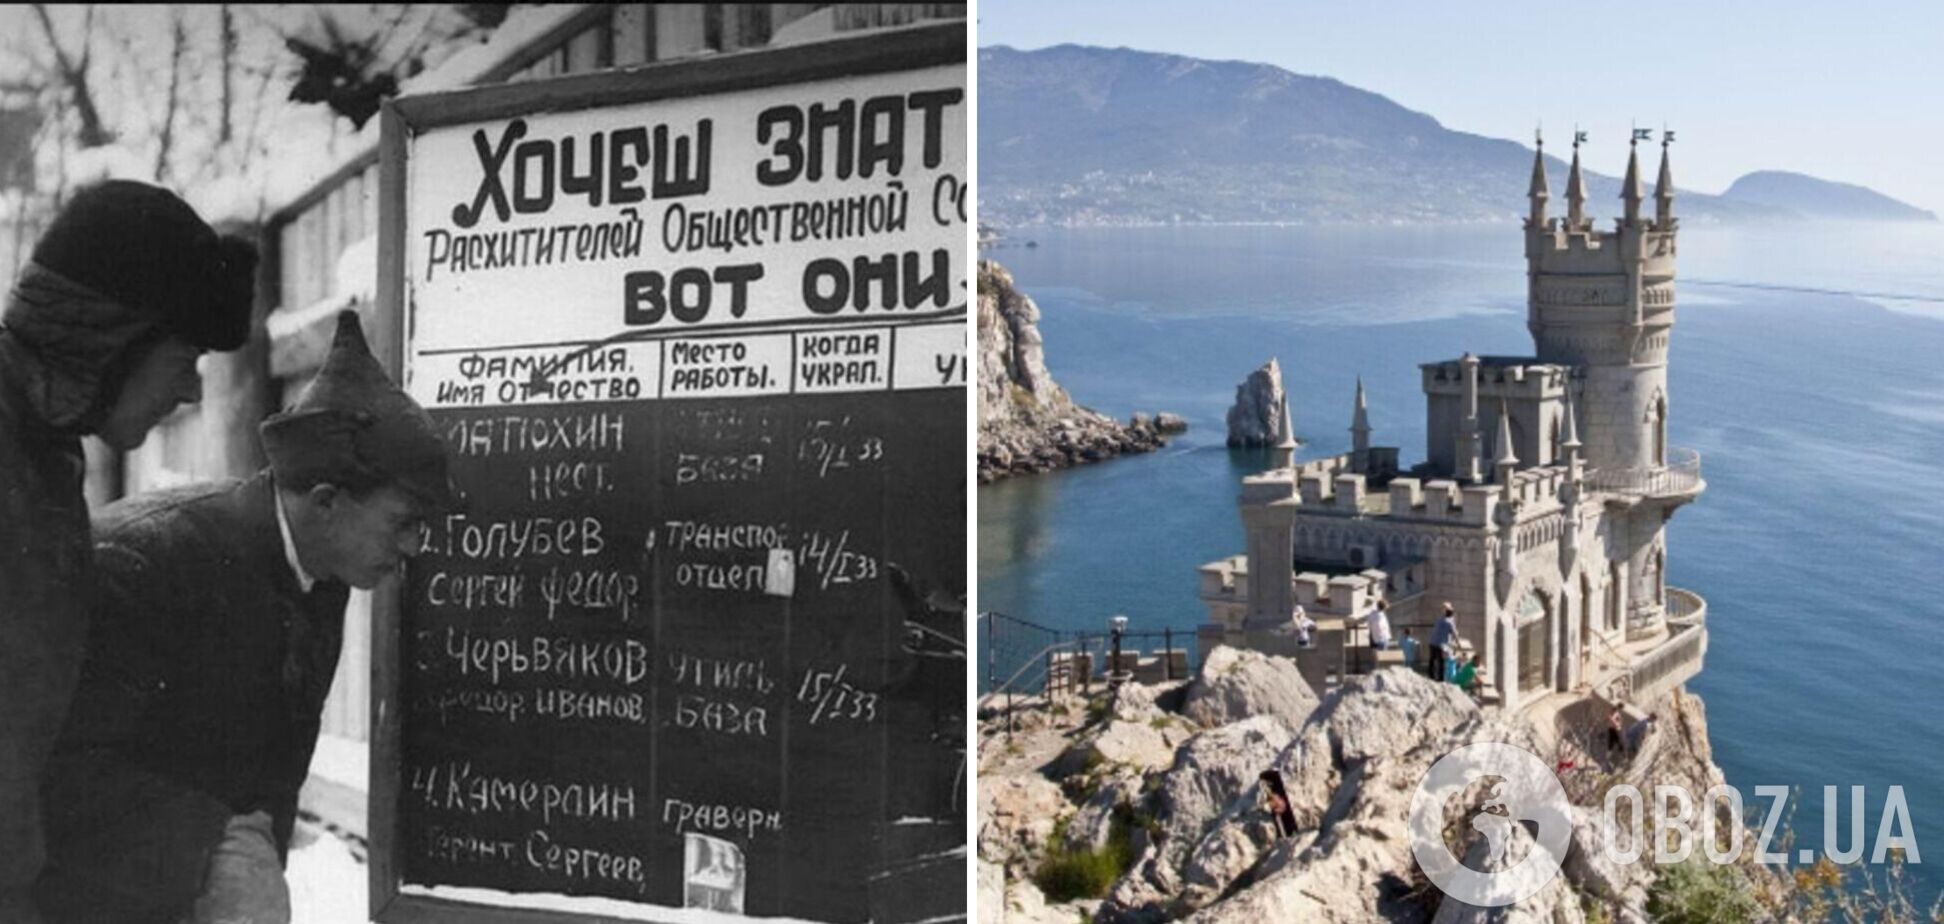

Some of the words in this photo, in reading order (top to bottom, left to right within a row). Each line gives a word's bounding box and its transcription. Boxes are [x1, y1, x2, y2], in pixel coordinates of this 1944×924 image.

[756, 87, 965, 187] ЗНАТ
[624, 262, 764, 326] ВОТ
[801, 248, 950, 315] ОНИ
[802, 334, 880, 358] КОГДА
[671, 364, 776, 392] РАБОТЫ.
[802, 360, 883, 388] УКРАЛ.
